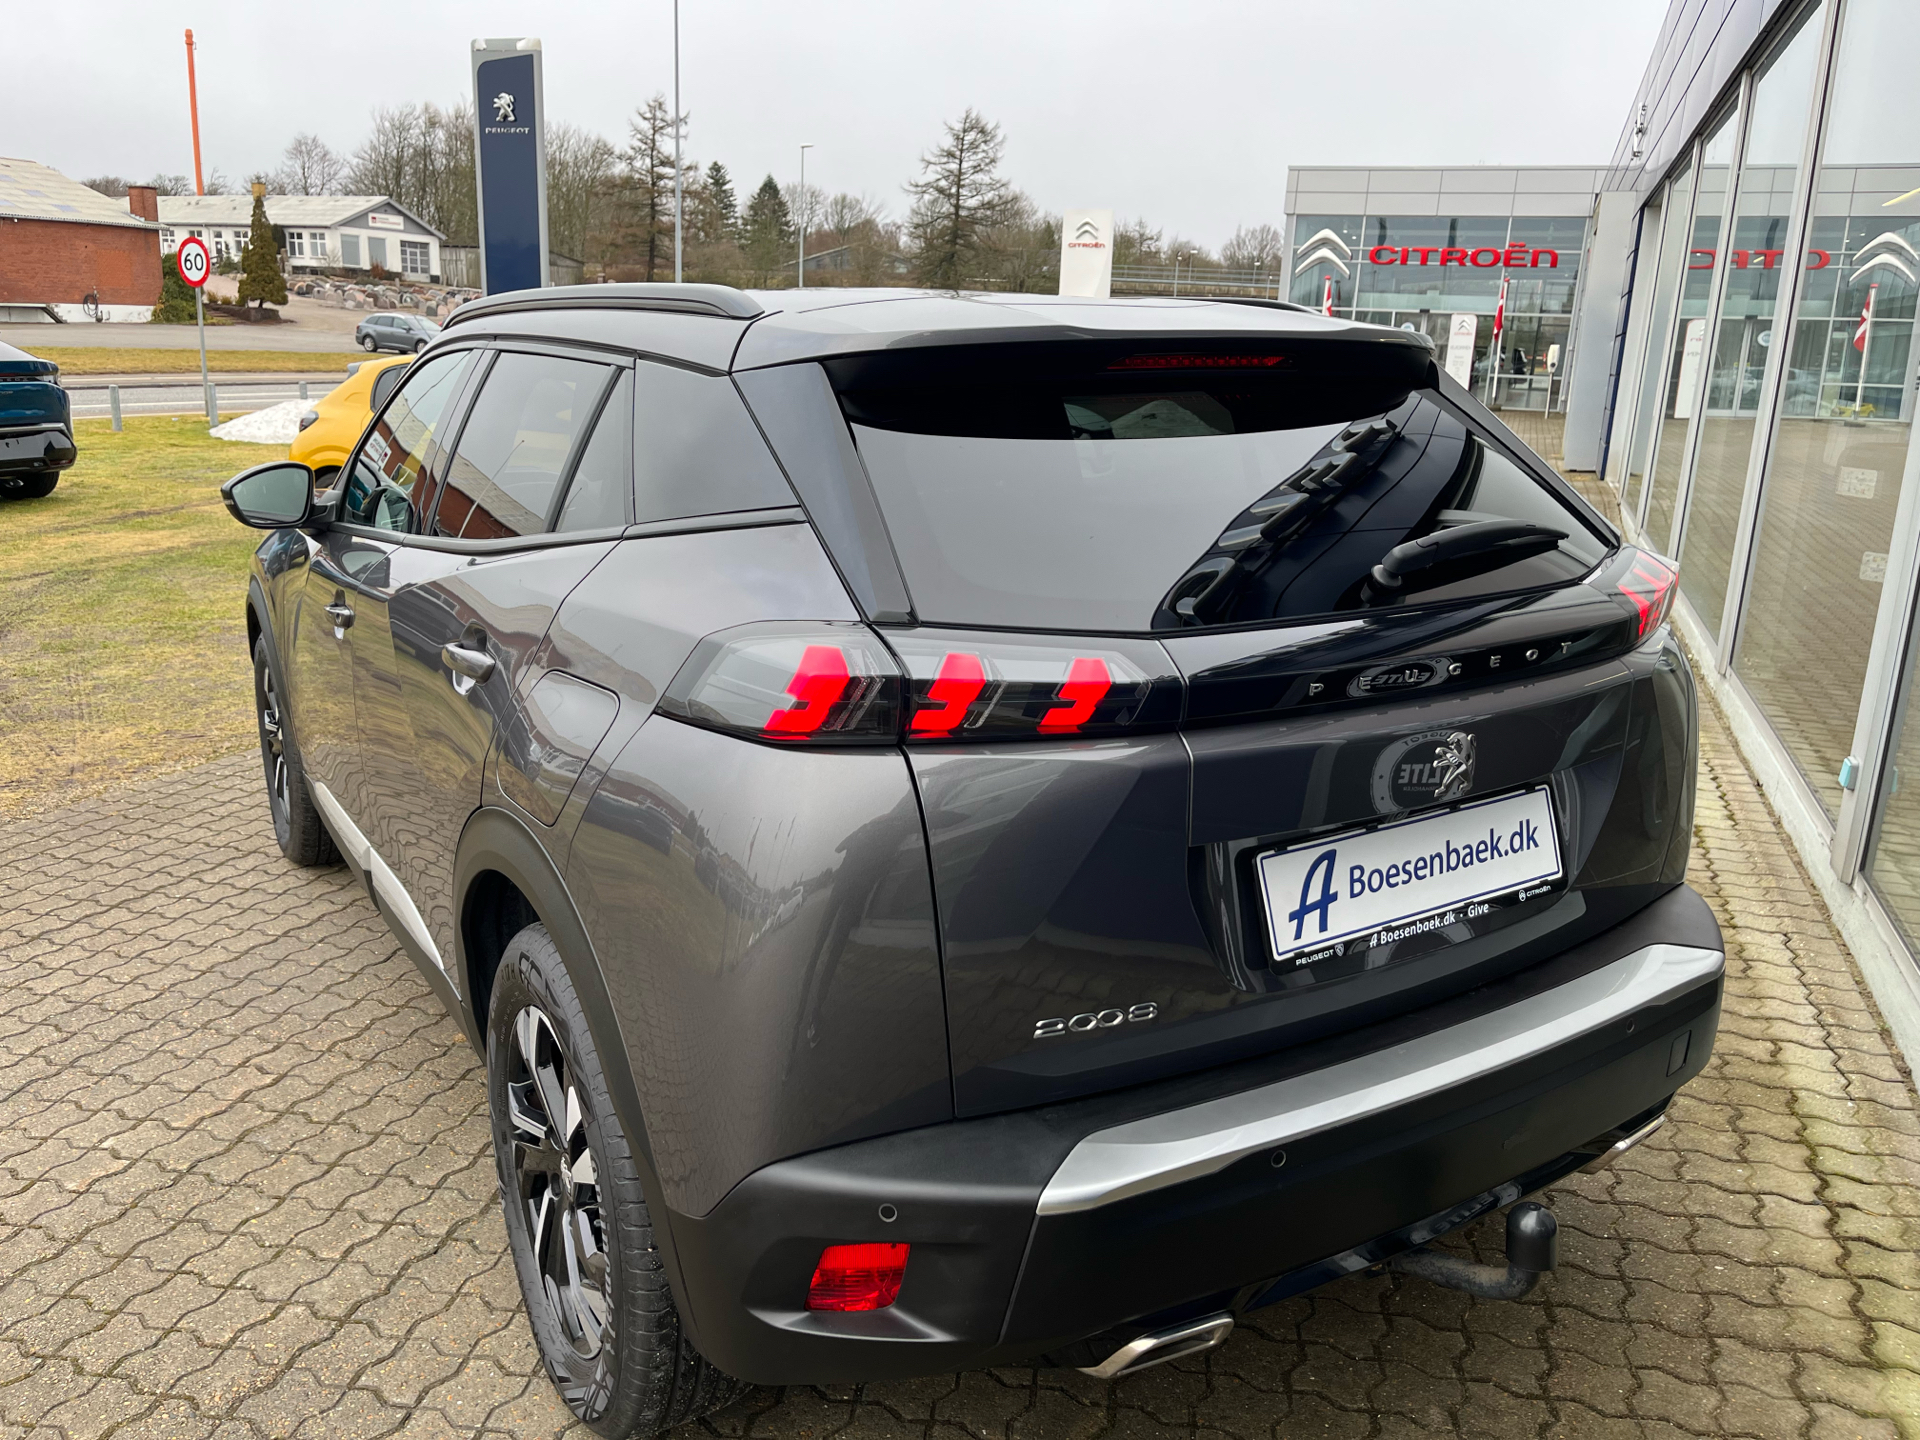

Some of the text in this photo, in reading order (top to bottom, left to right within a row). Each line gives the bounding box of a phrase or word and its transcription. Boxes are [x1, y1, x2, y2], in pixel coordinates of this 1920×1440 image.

[485, 127, 530, 135] PEUGEOT
[184, 252, 204, 272] 60
[1369, 242, 1559, 268] CITROËN
[1308, 641, 1573, 697] PEUGEOT
[1349, 818, 1540, 899] Boesenbaek.dk
[1380, 910, 1456, 946] Boesenbaek.dk
[1467, 903, 1490, 918] Give
[1295, 949, 1334, 966] PEUGEOT
[1033, 1002, 1158, 1039] 2008
